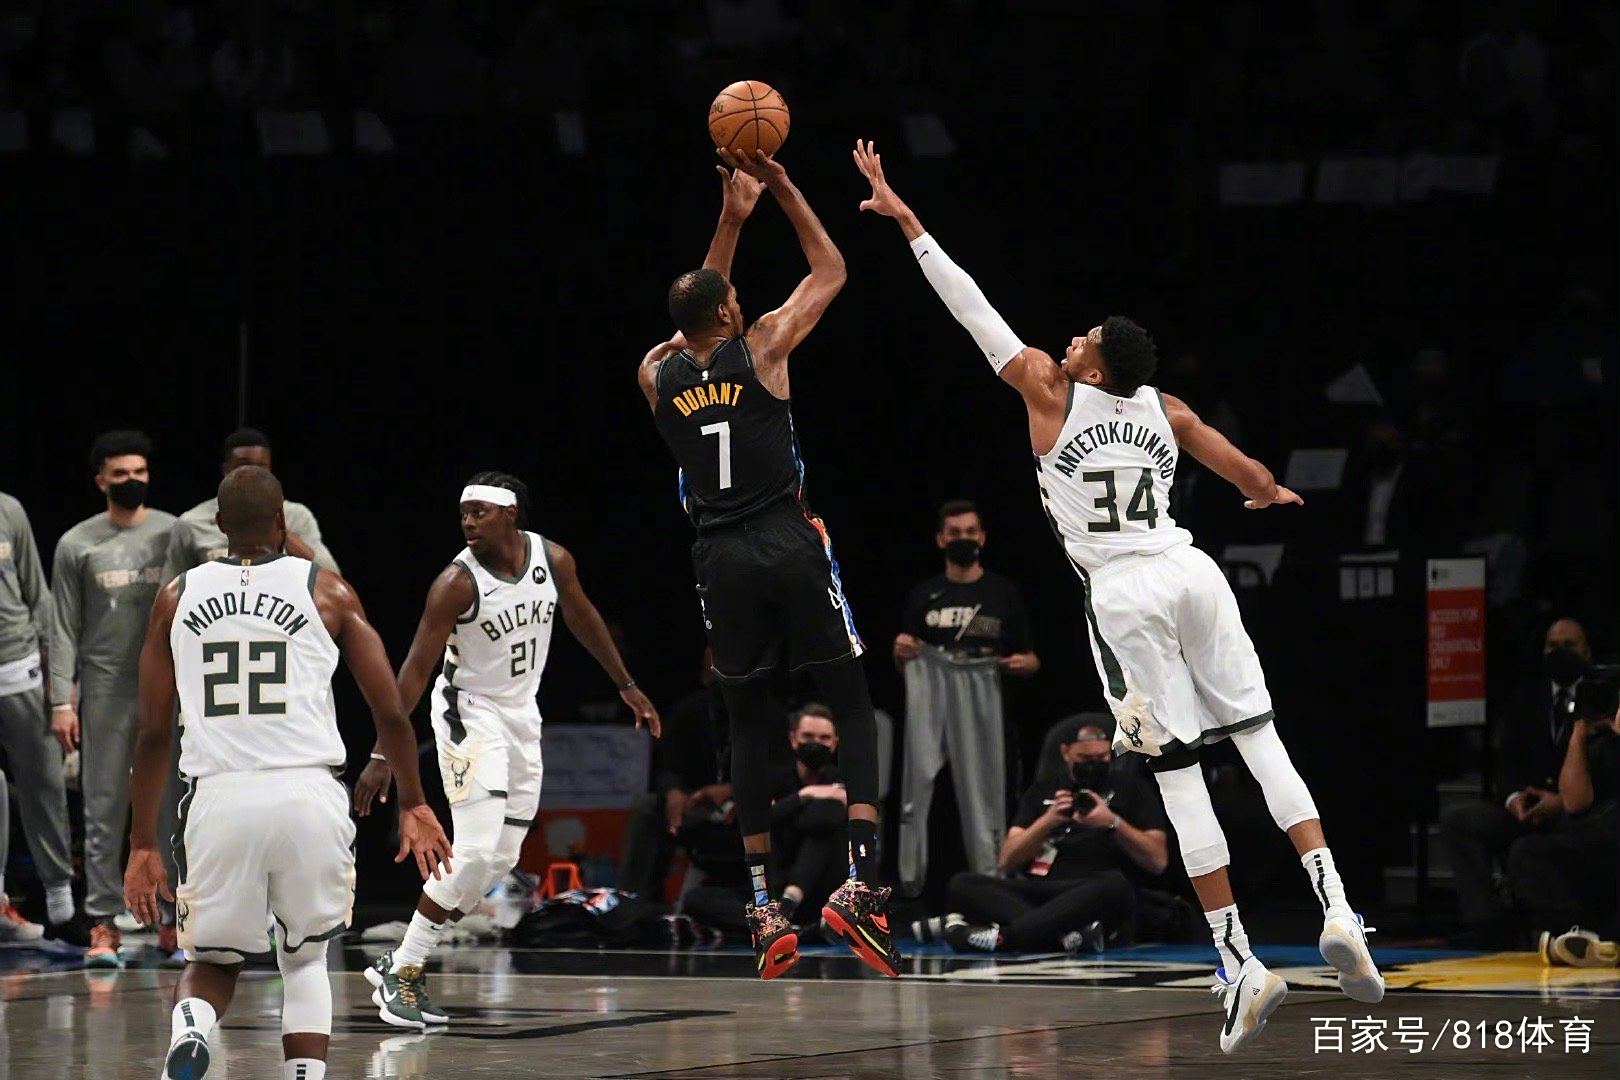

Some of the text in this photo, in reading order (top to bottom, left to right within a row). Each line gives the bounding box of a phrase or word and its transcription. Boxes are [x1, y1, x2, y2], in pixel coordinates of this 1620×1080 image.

[672, 382, 743, 417] DURANT
[700, 421, 731, 490] 7
[1054, 421, 1174, 480] ANTETOKOUNMPO
[1082, 467, 1159, 532] 34
[182, 591, 309, 636] MIDDLETON
[480, 600, 554, 642] BUCKS
[202, 640, 287, 718] 22
[511, 637, 537, 678] 21
